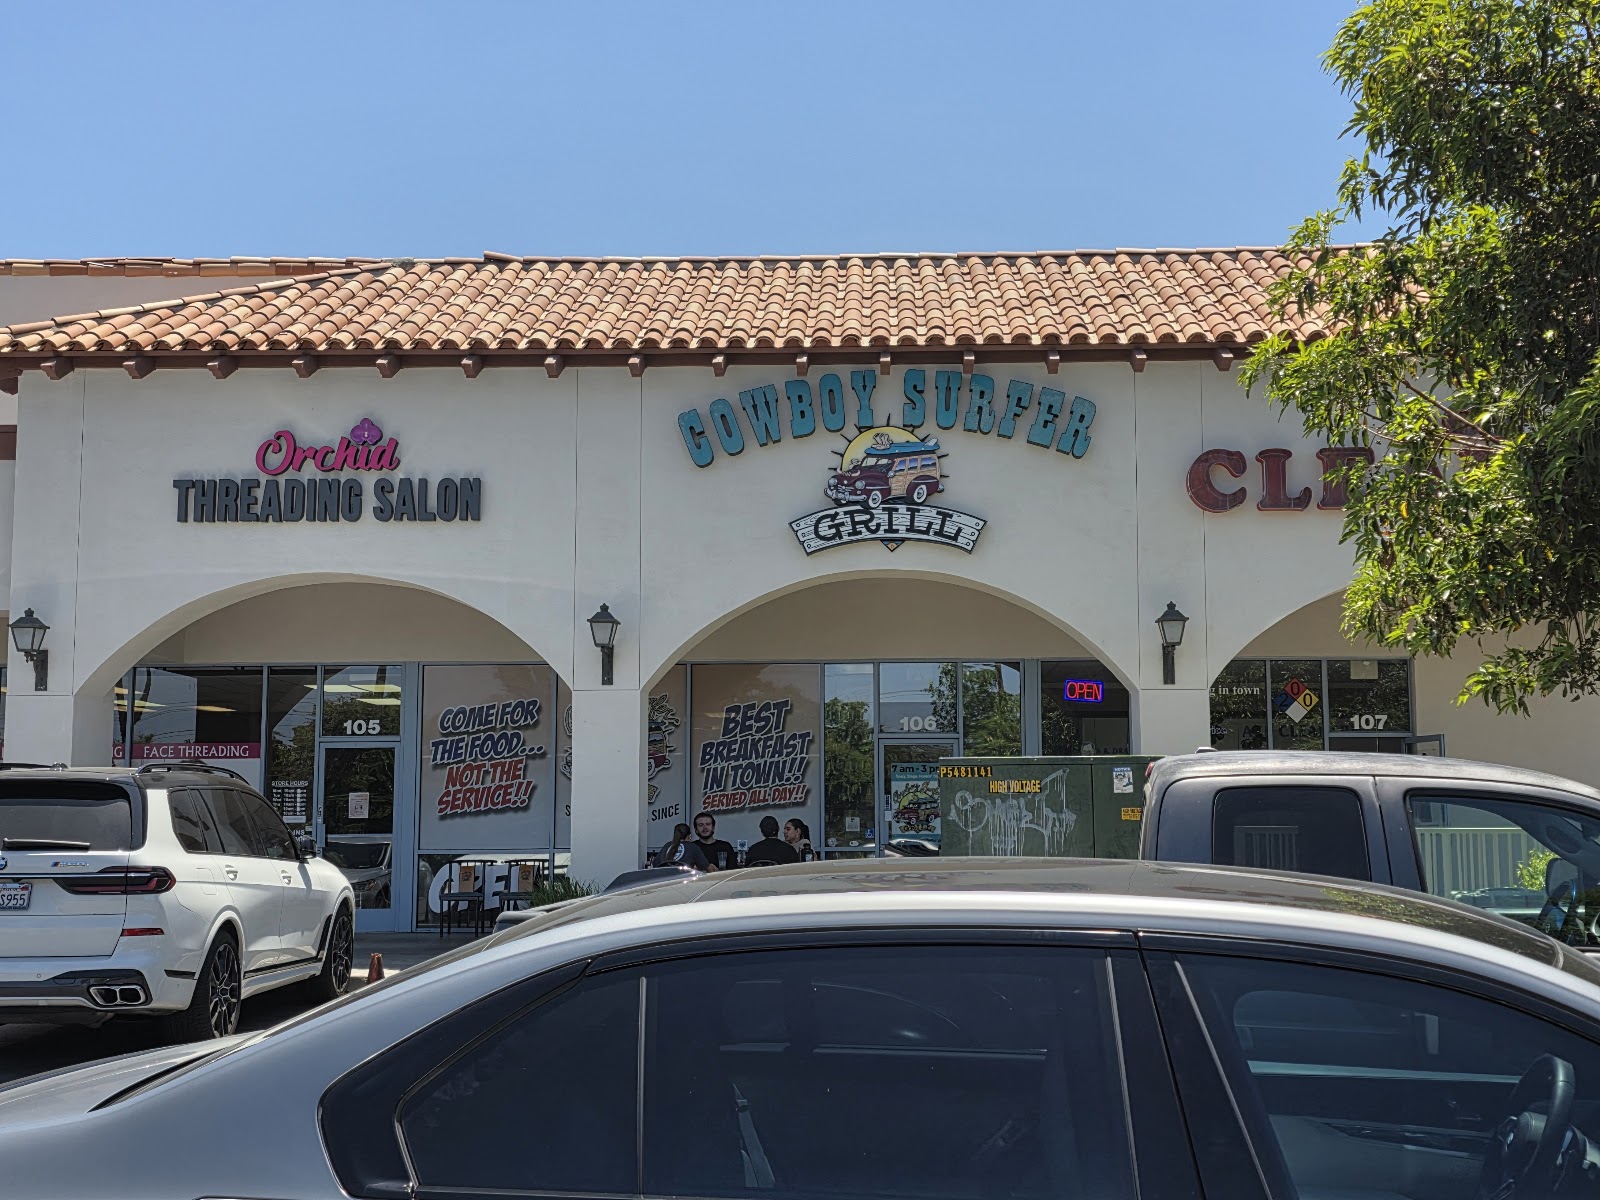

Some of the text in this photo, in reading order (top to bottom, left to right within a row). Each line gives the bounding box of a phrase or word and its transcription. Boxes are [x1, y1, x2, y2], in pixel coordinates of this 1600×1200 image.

[678, 368, 1097, 468] COWBOY SURFER
[255, 429, 400, 476] Orchid
[173, 477, 482, 523] THREADING SALON
[813, 505, 964, 543] GRILL
[1066, 681, 1102, 701] OPEN
[1218, 685, 1229, 695] in
[1232, 685, 1260, 695] town
[1279, 692, 1313, 708] 2 0
[1290, 681, 1300, 696] 0
[343, 719, 381, 736] 105
[438, 697, 541, 735] COME FOR
[720, 699, 791, 739] BEST
[900, 716, 937, 731] 106
[1350, 714, 1388, 730] 107
[143, 745, 249, 758] FACE THREADING
[430, 736, 468, 765] THE
[700, 730, 813, 768] BREAKFAST
[444, 757, 526, 791] NOT THE
[702, 755, 808, 793] IN TOWN!!
[892, 765, 898, 773] 7
[921, 765, 927, 773] 3
[940, 766, 992, 778] P5481141
[437, 779, 534, 815] SERVICE!!
[702, 784, 808, 811] SERVED ALL DAY!!
[989, 780, 1041, 793] HIGH VOLTAGE
[651, 803, 680, 822] SINCE
